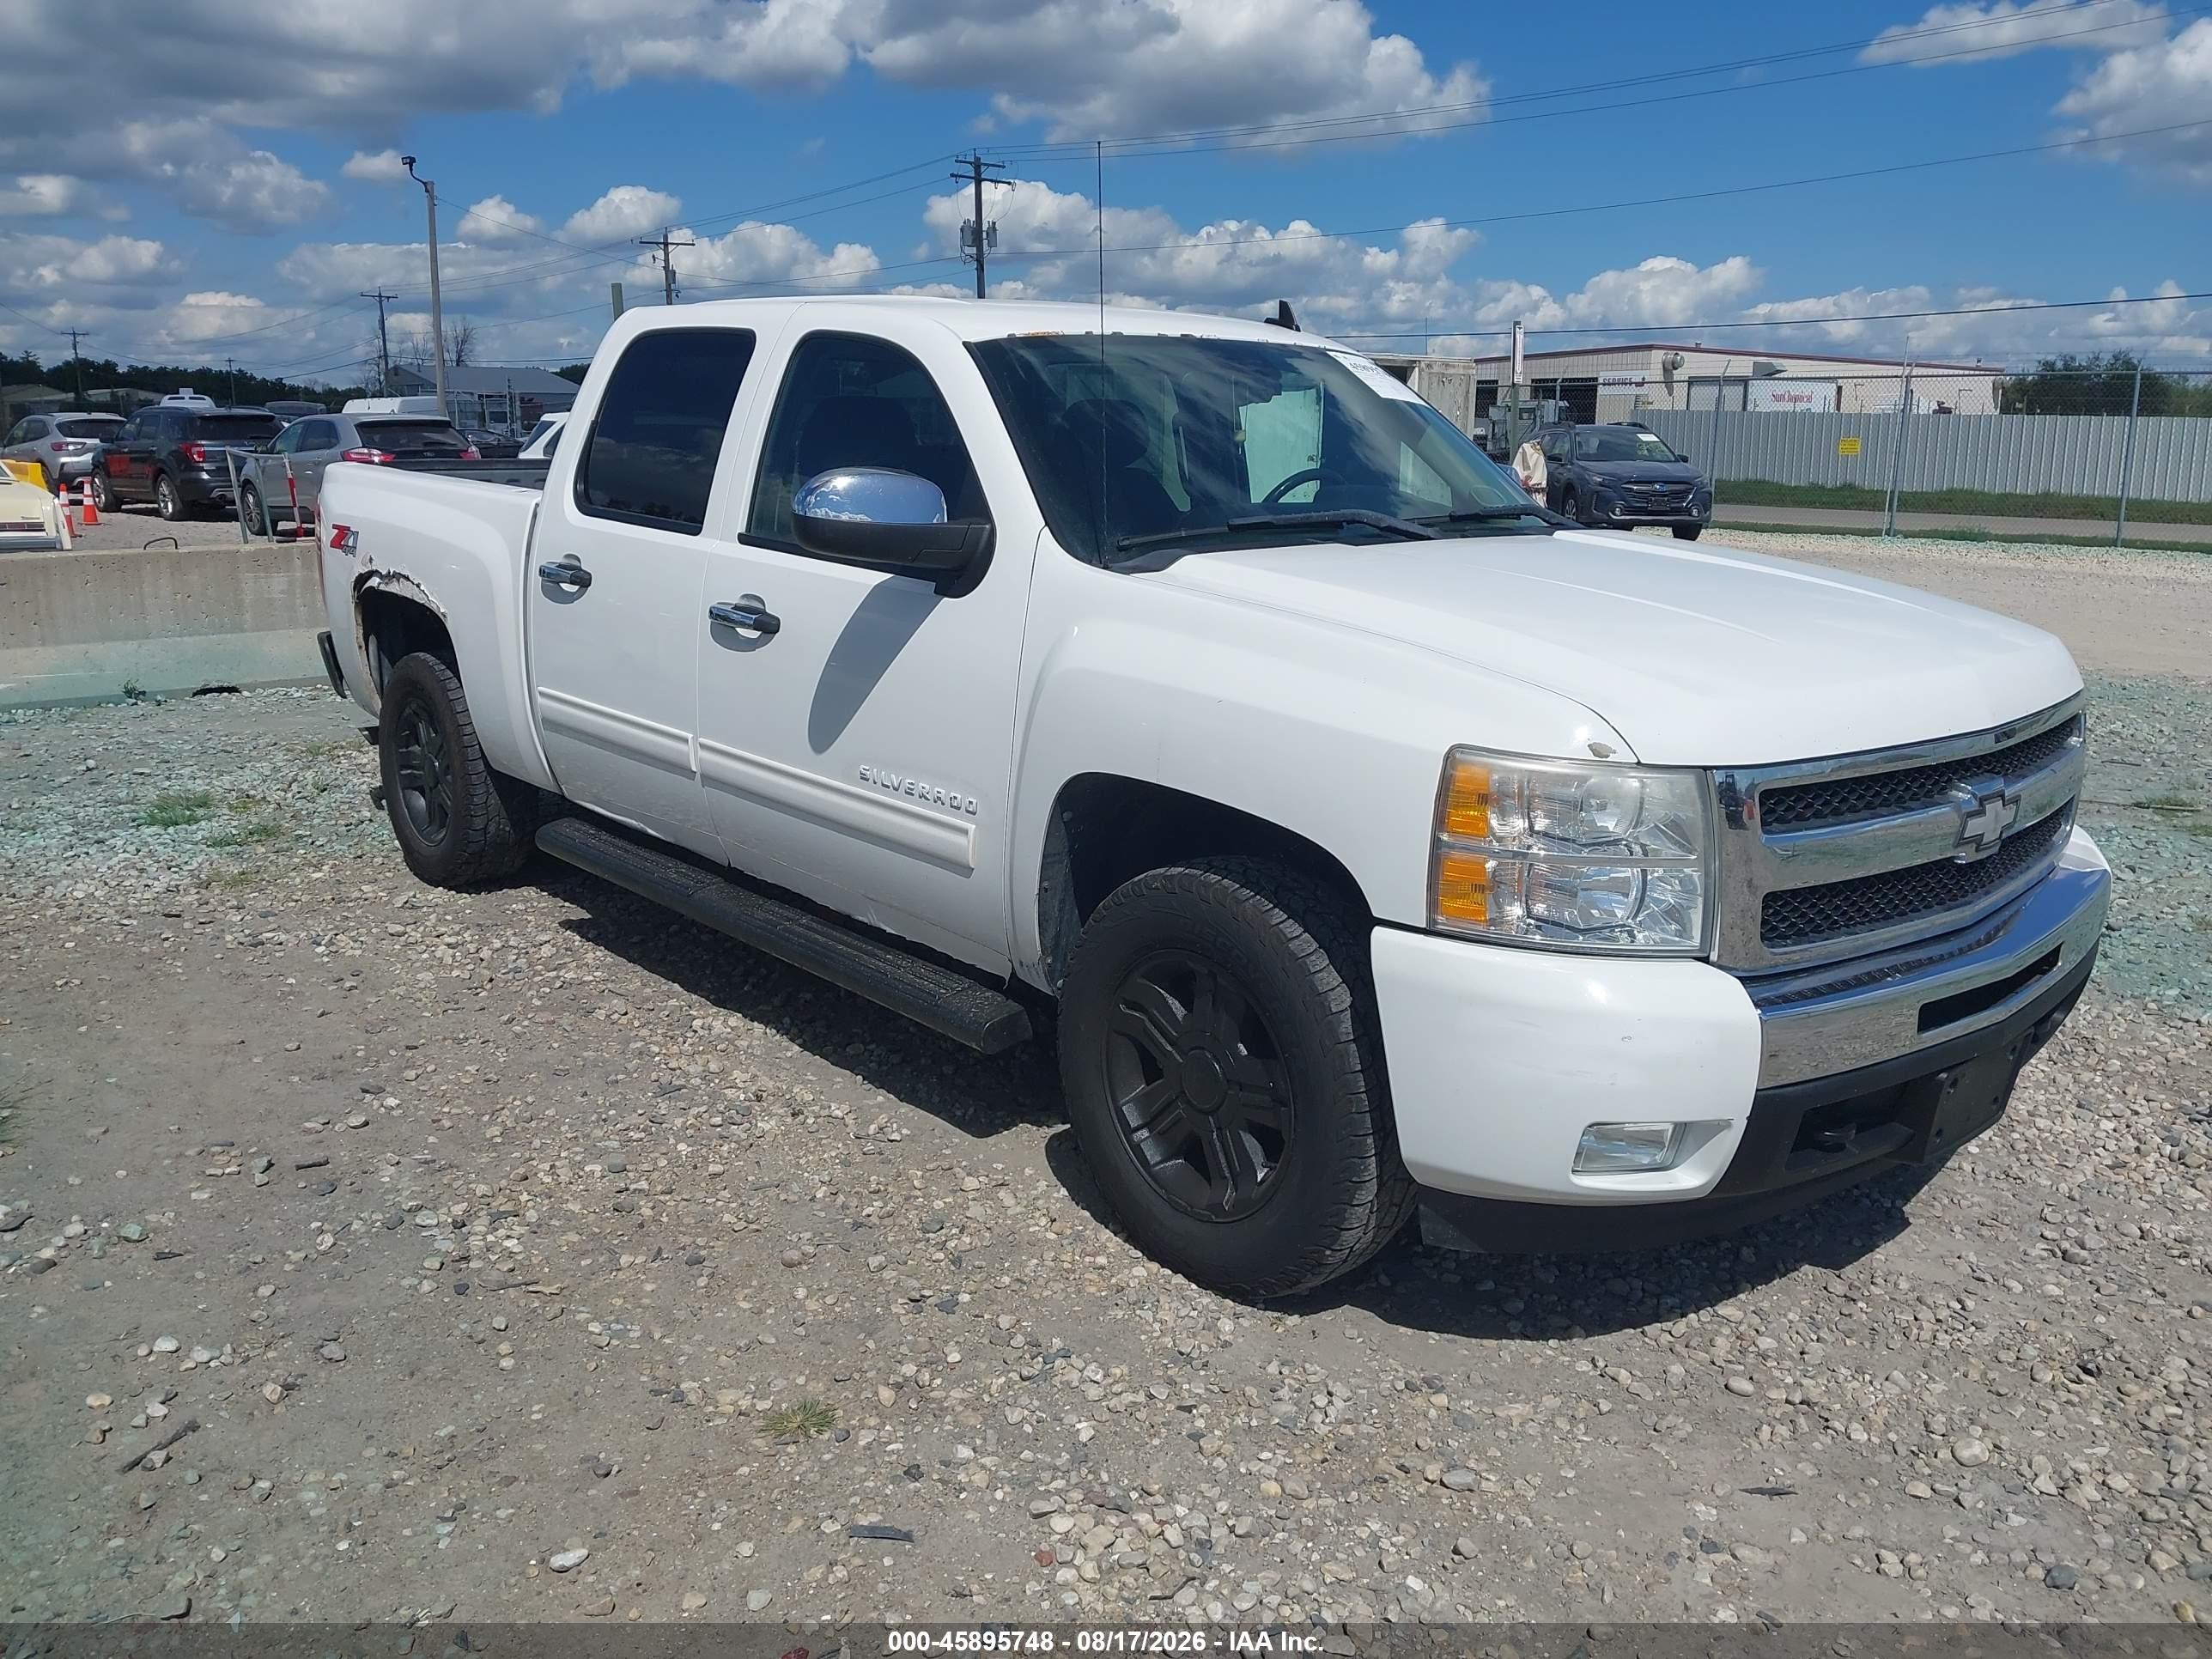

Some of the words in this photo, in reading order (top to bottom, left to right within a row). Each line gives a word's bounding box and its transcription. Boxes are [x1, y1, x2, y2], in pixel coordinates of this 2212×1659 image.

[1602, 378, 1633, 386] SERVICE
[1771, 390, 1814, 404] SunChemical
[859, 764, 979, 816] SILVERADO
